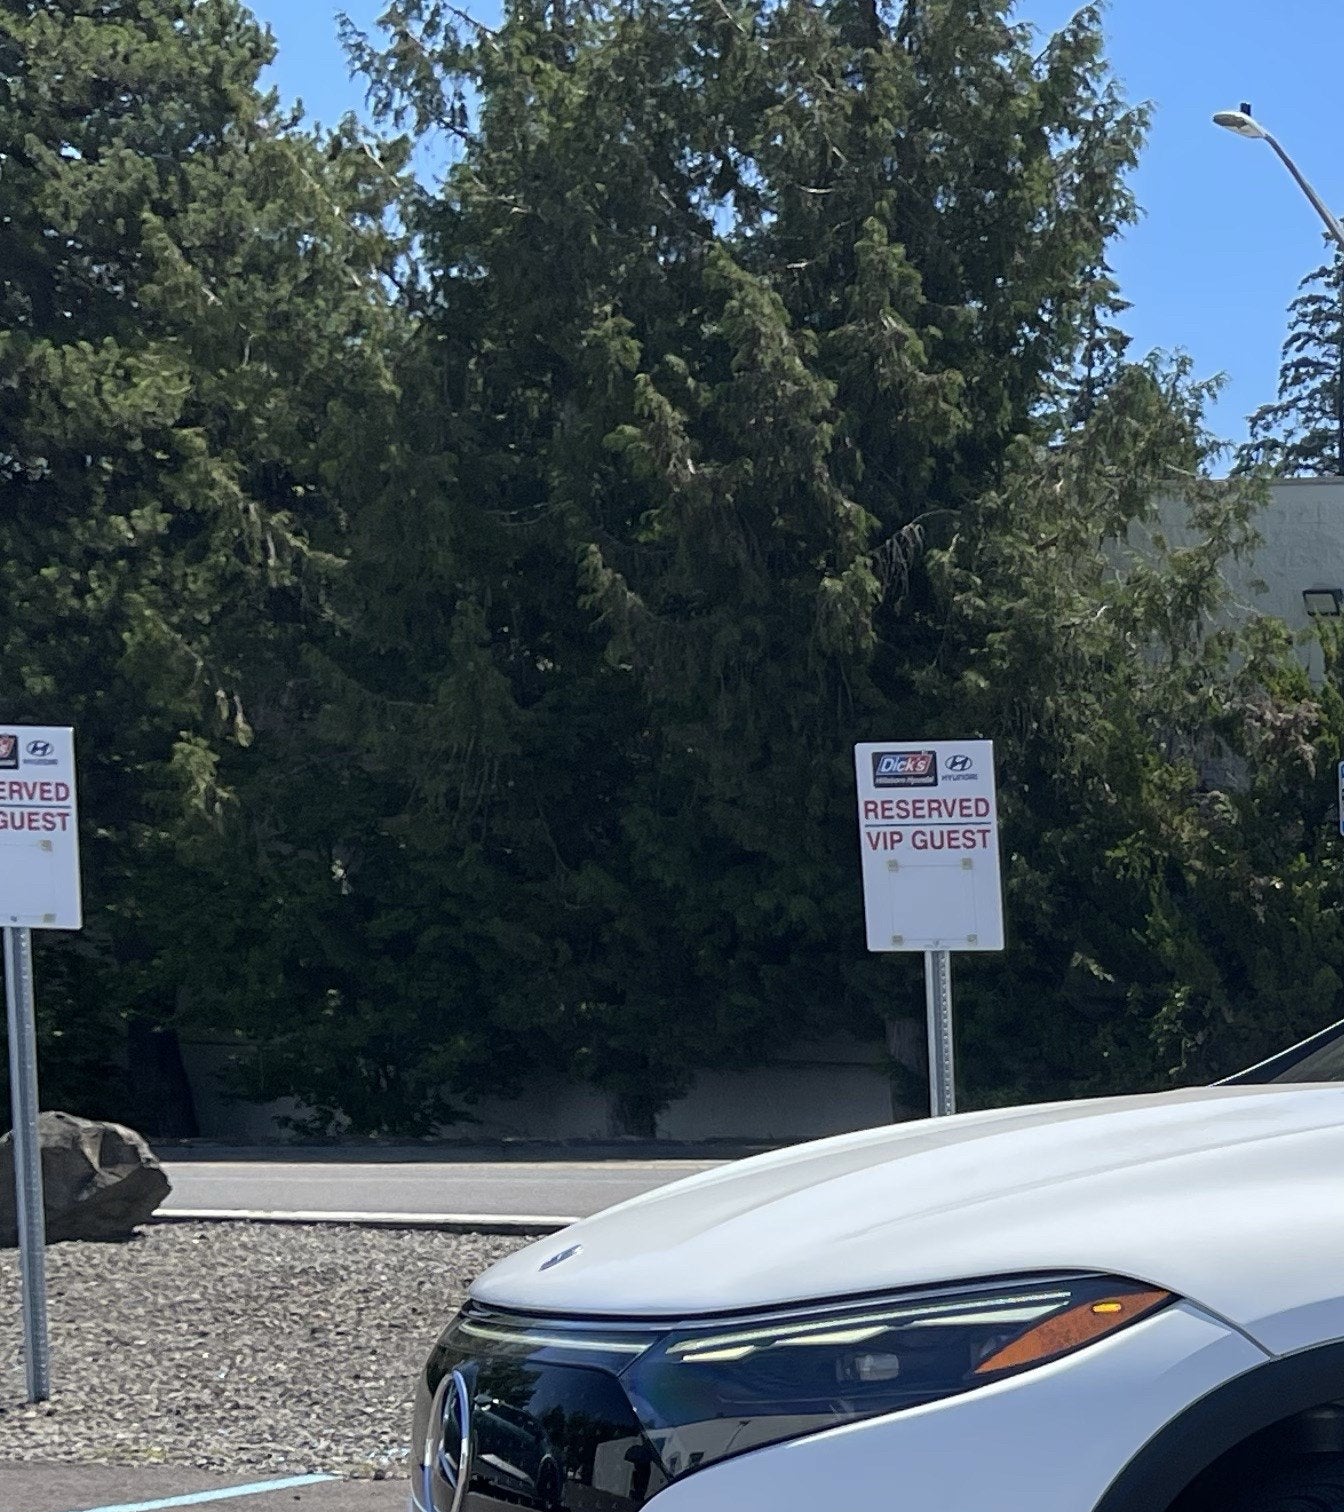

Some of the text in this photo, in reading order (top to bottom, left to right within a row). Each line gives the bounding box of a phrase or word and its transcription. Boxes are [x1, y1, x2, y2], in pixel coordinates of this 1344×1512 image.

[864, 798, 990, 820] RESERVED
[866, 829, 991, 851] VIP GUEST
